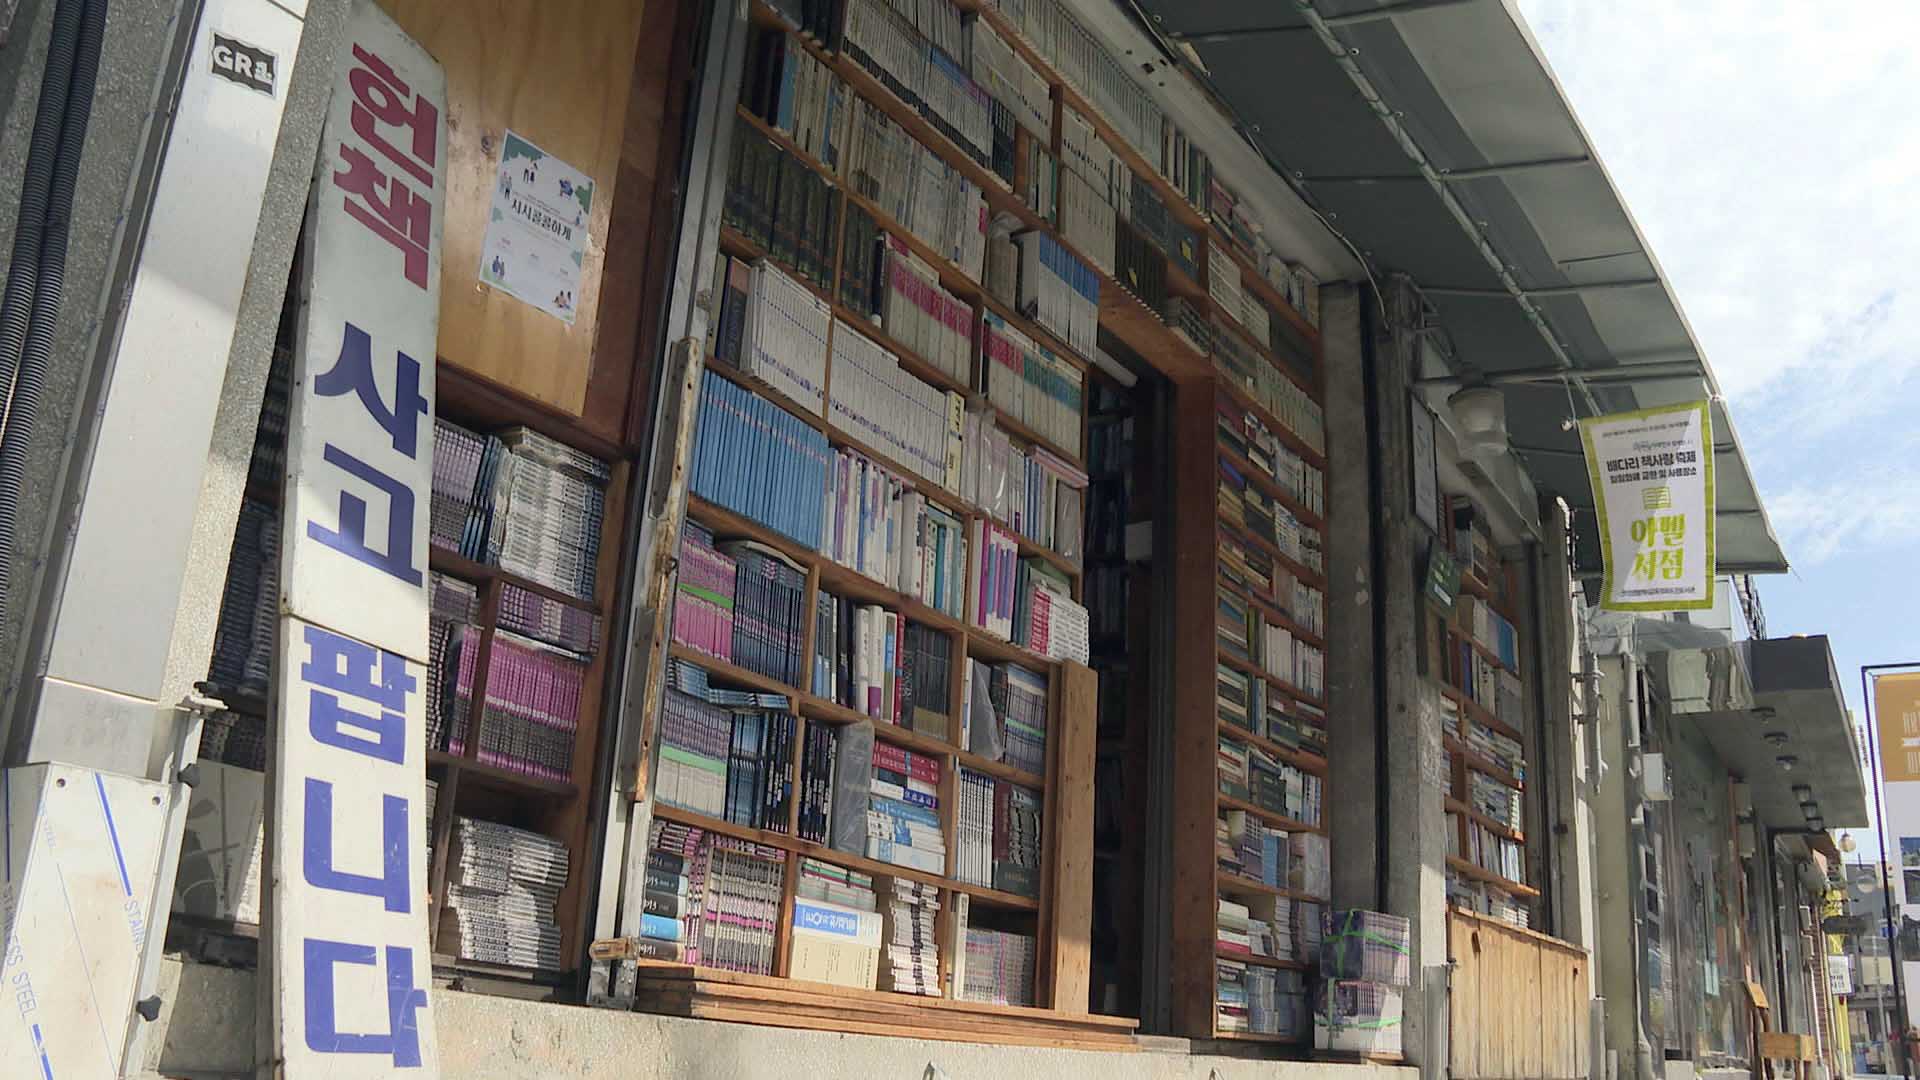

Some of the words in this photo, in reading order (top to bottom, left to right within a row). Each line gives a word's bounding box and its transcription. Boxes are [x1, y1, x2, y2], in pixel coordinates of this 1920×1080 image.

[333, 42, 439, 290] 헌책
[307, 321, 428, 588] 사고
[1606, 456, 1639, 472] 배다리
[1631, 513, 1685, 548] 아벨
[1632, 548, 1684, 581] 서점
[301, 625, 428, 1068] 팝니다
[12, 971, 37, 1019] STEEL
